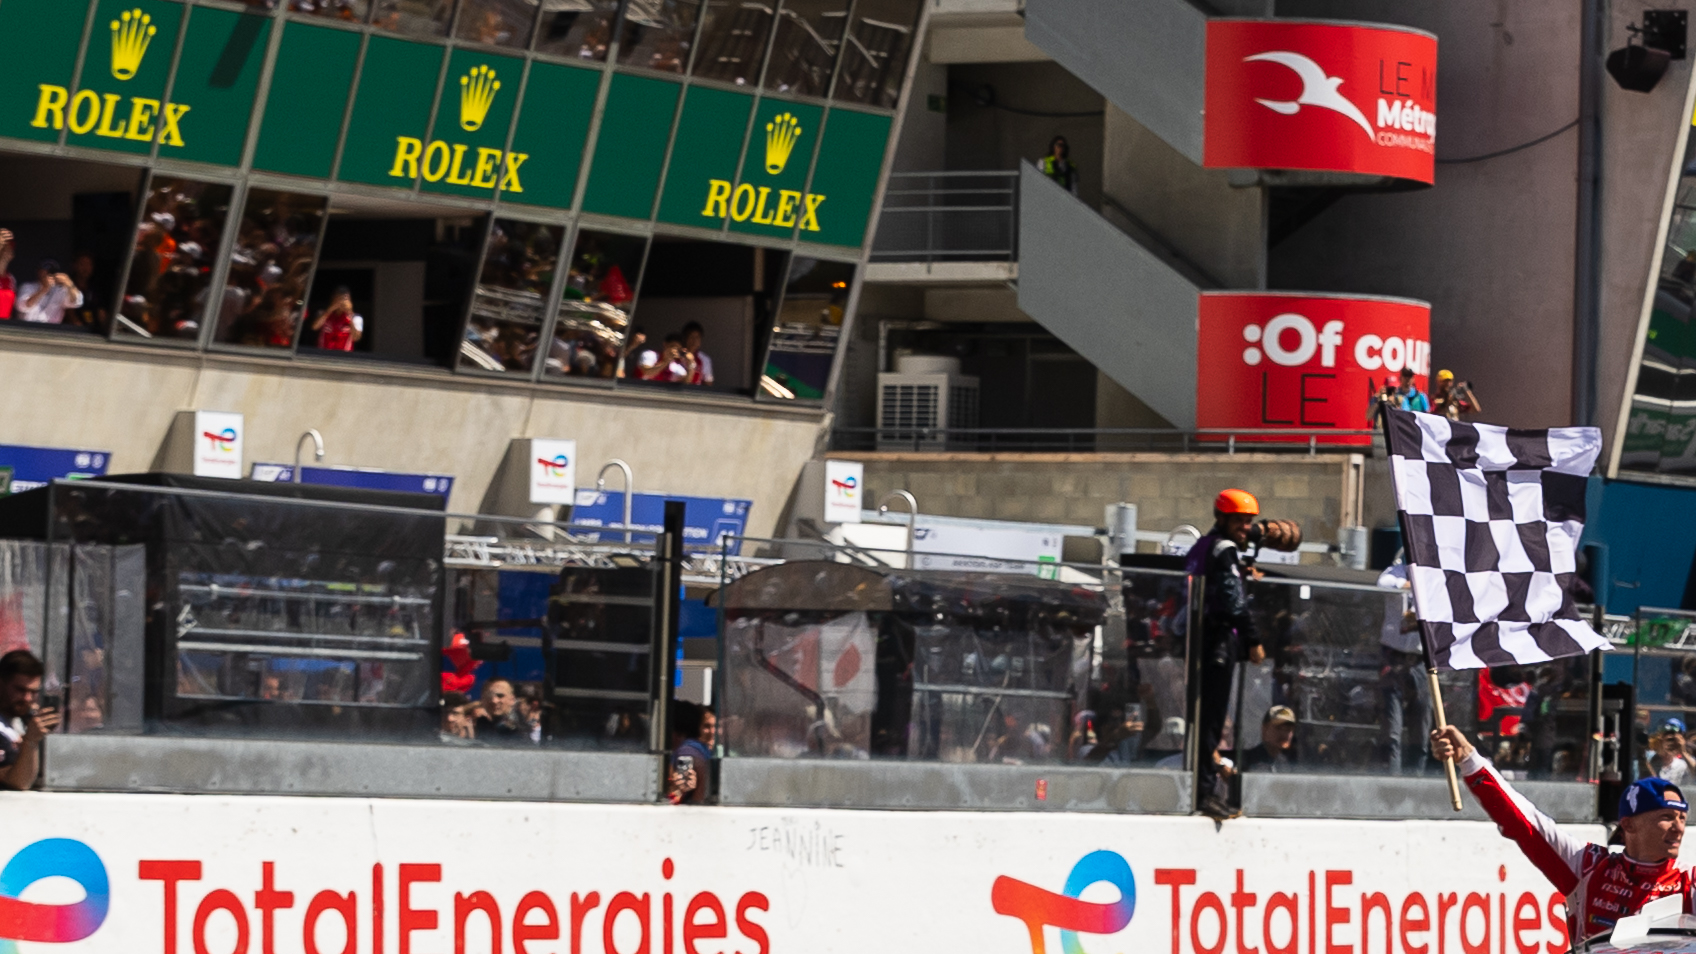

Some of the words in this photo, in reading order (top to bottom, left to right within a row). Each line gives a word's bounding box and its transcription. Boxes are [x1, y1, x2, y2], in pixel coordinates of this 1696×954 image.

[1379, 60, 1411, 97] LE
[31, 84, 190, 147] ROLEX
[389, 136, 528, 193] ROLEX
[702, 179, 825, 232] ROLEX
[1261, 371, 1336, 427] LE
